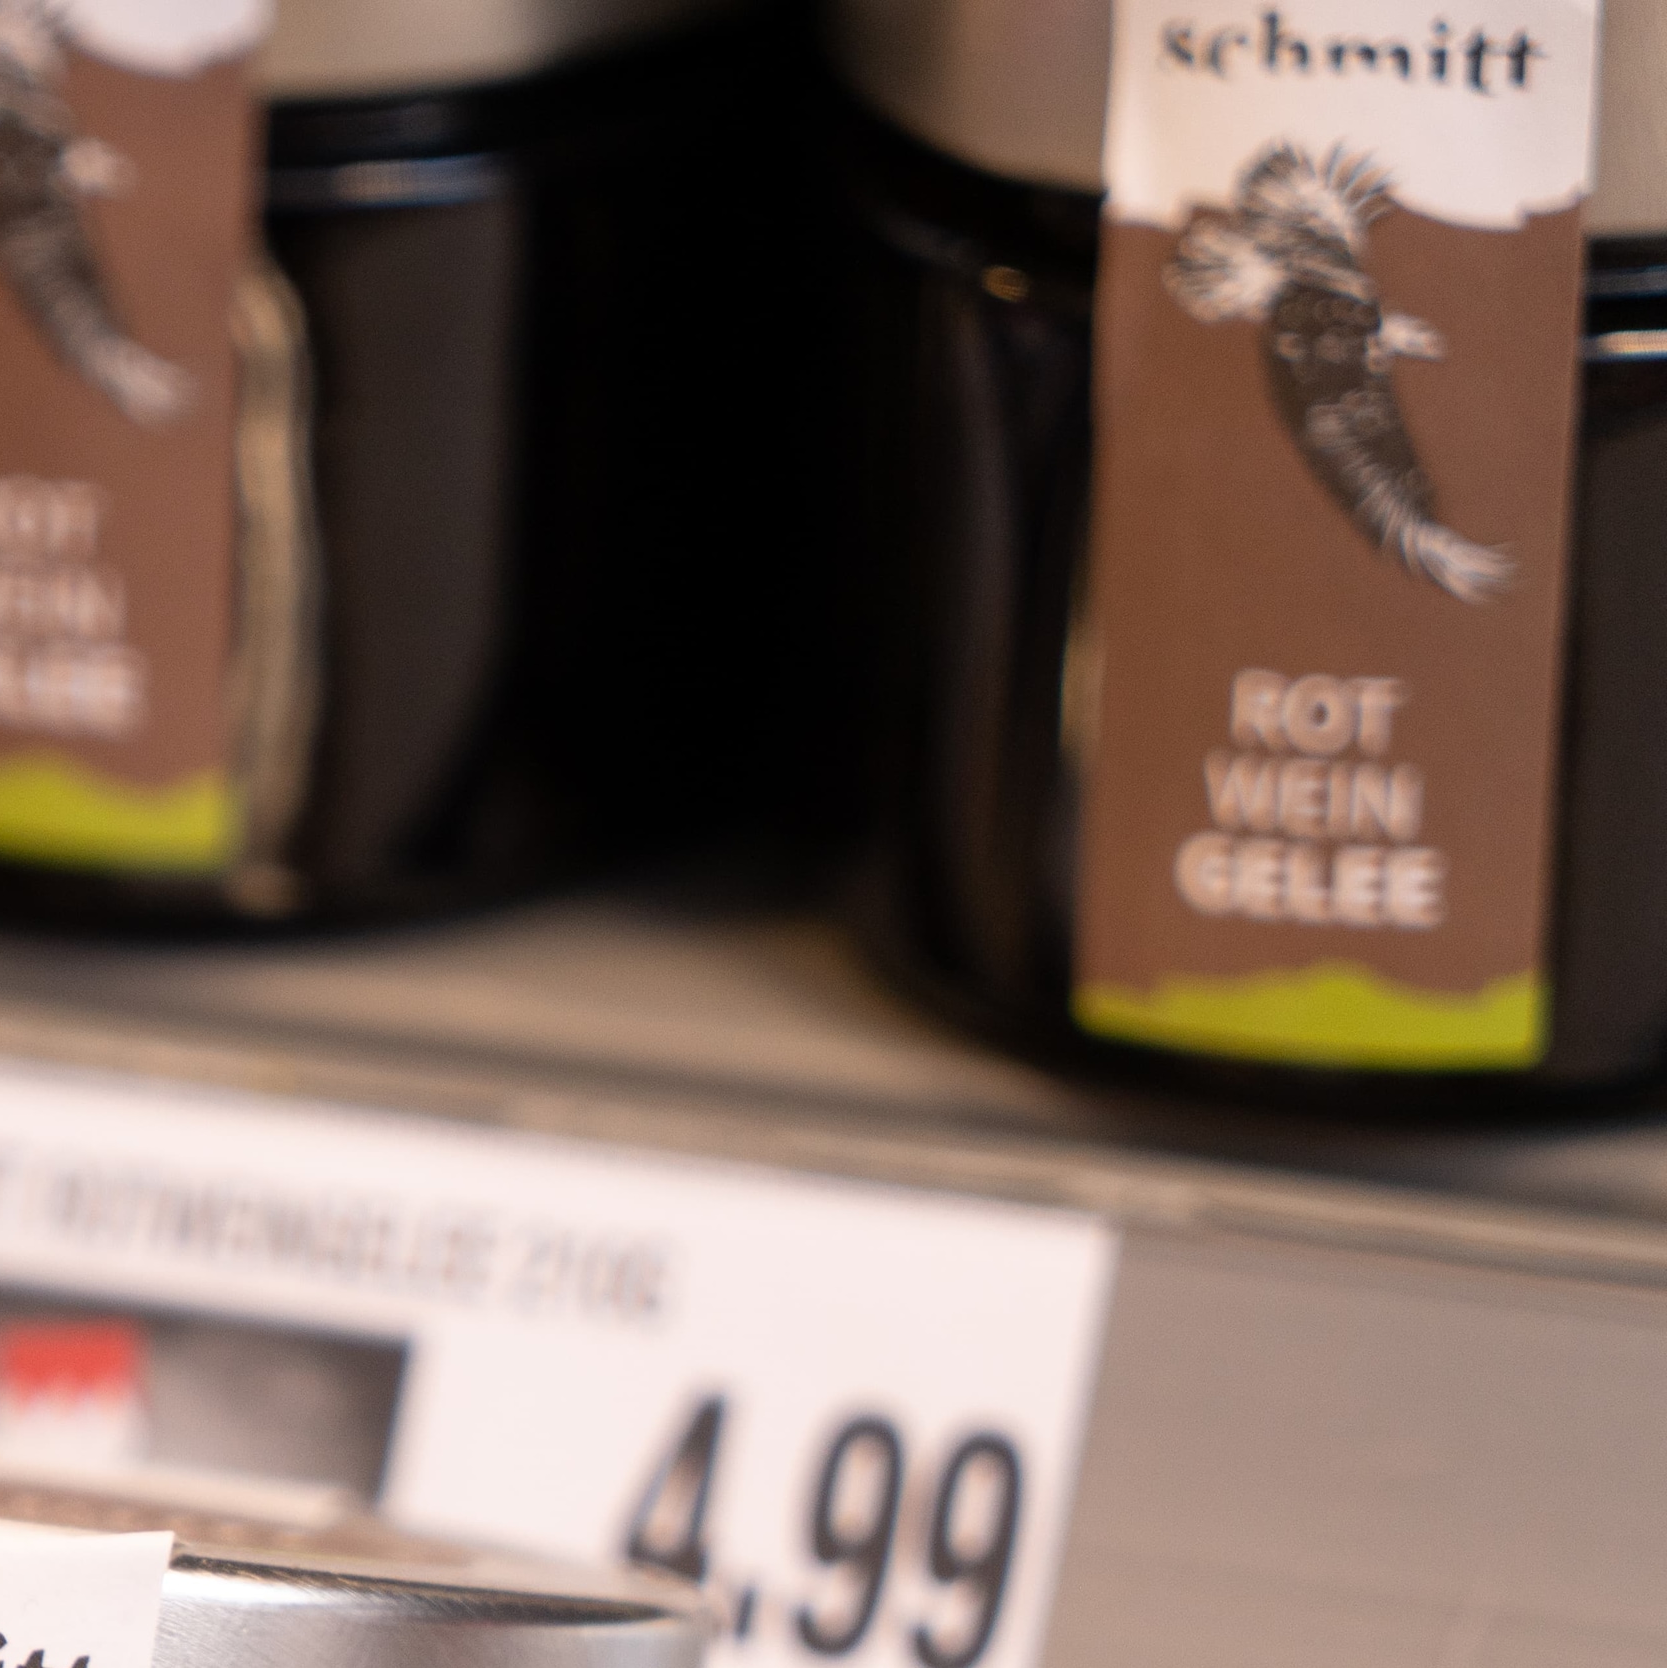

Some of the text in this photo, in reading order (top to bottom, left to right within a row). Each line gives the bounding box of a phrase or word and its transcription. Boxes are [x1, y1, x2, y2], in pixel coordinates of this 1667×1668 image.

[1158, 8, 1549, 94] schmitt
[1229, 667, 1407, 756] ROT
[1204, 750, 1425, 843] WEIN
[1173, 831, 1447, 930] GELEE
